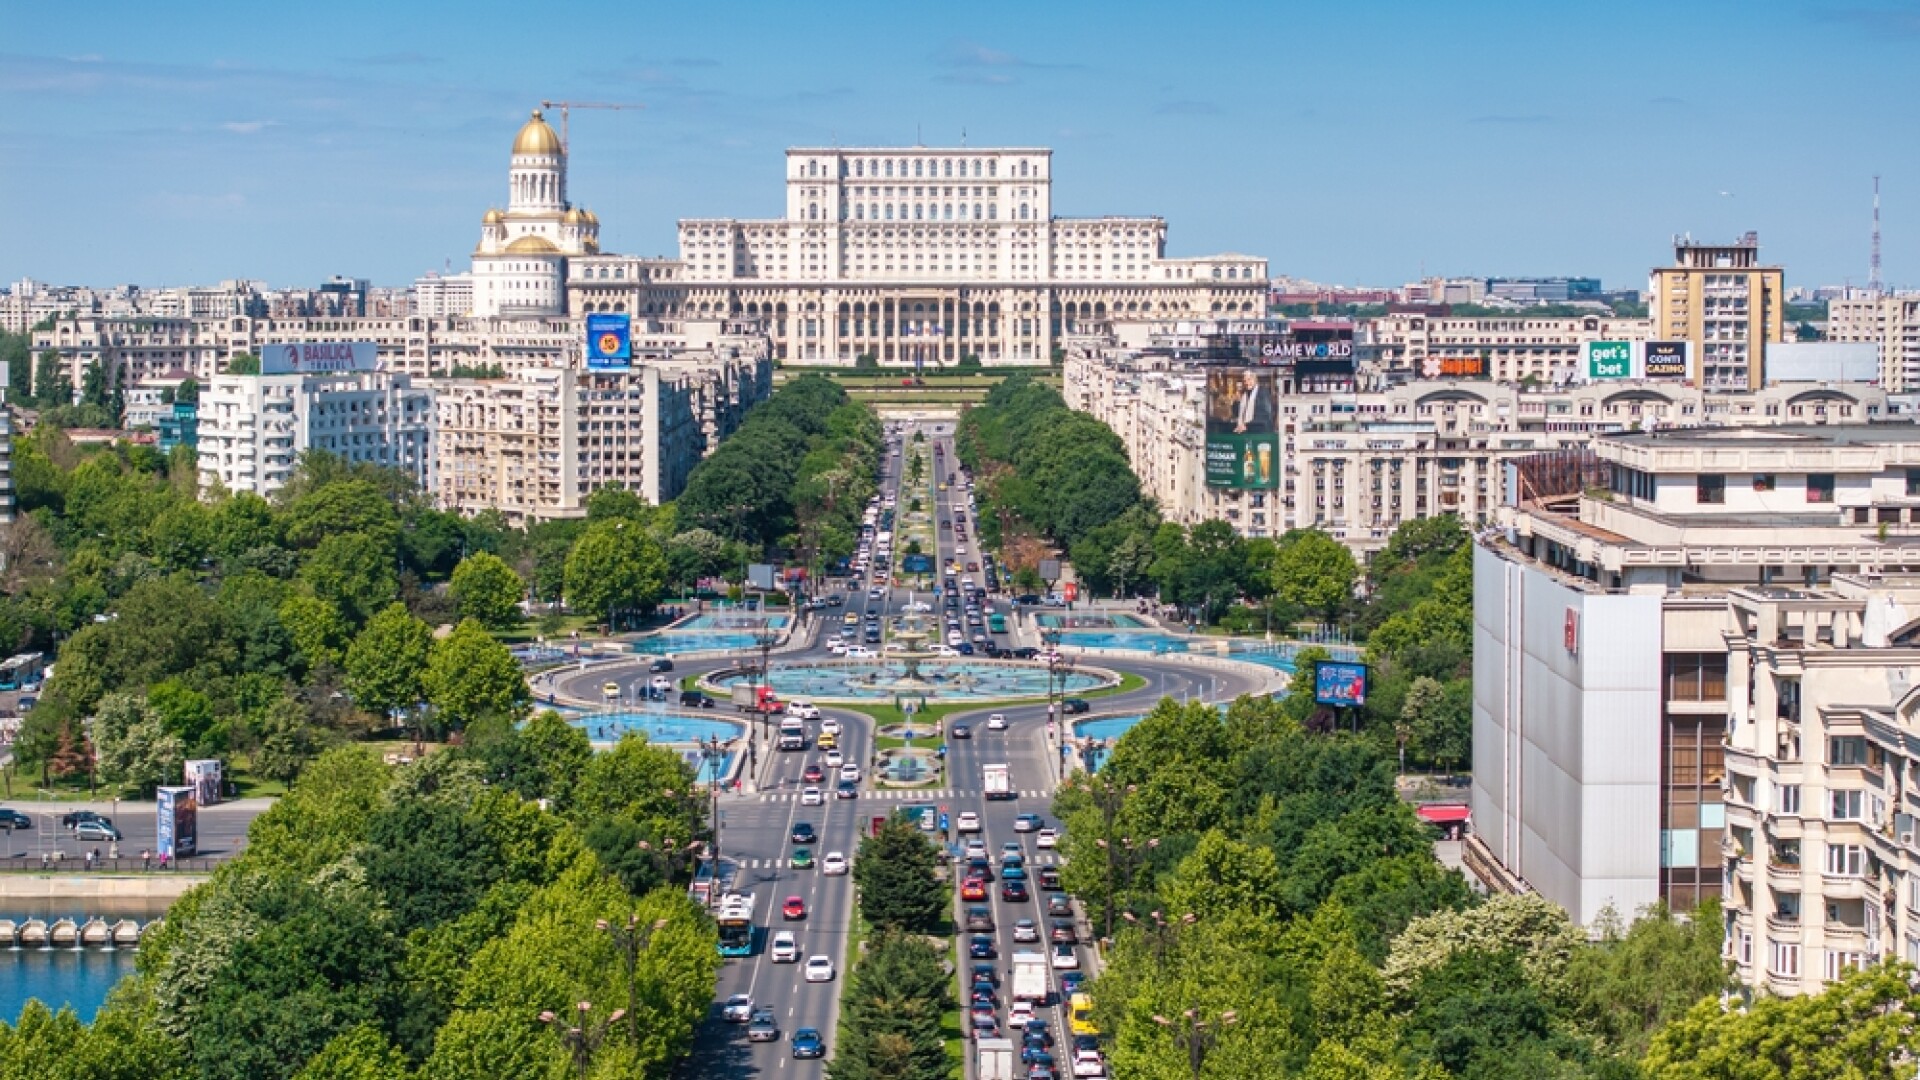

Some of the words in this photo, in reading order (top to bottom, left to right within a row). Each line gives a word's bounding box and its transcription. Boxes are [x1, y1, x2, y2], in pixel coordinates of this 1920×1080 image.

[303, 344, 355, 367] BASILICA
[1262, 343, 1302, 357] GAME
[1305, 343, 1351, 358] WORLD
[1591, 345, 1629, 362] get's
[311, 361, 346, 370] TRAVEL
[1648, 354, 1681, 364] CONTI
[1597, 363, 1623, 376] bet
